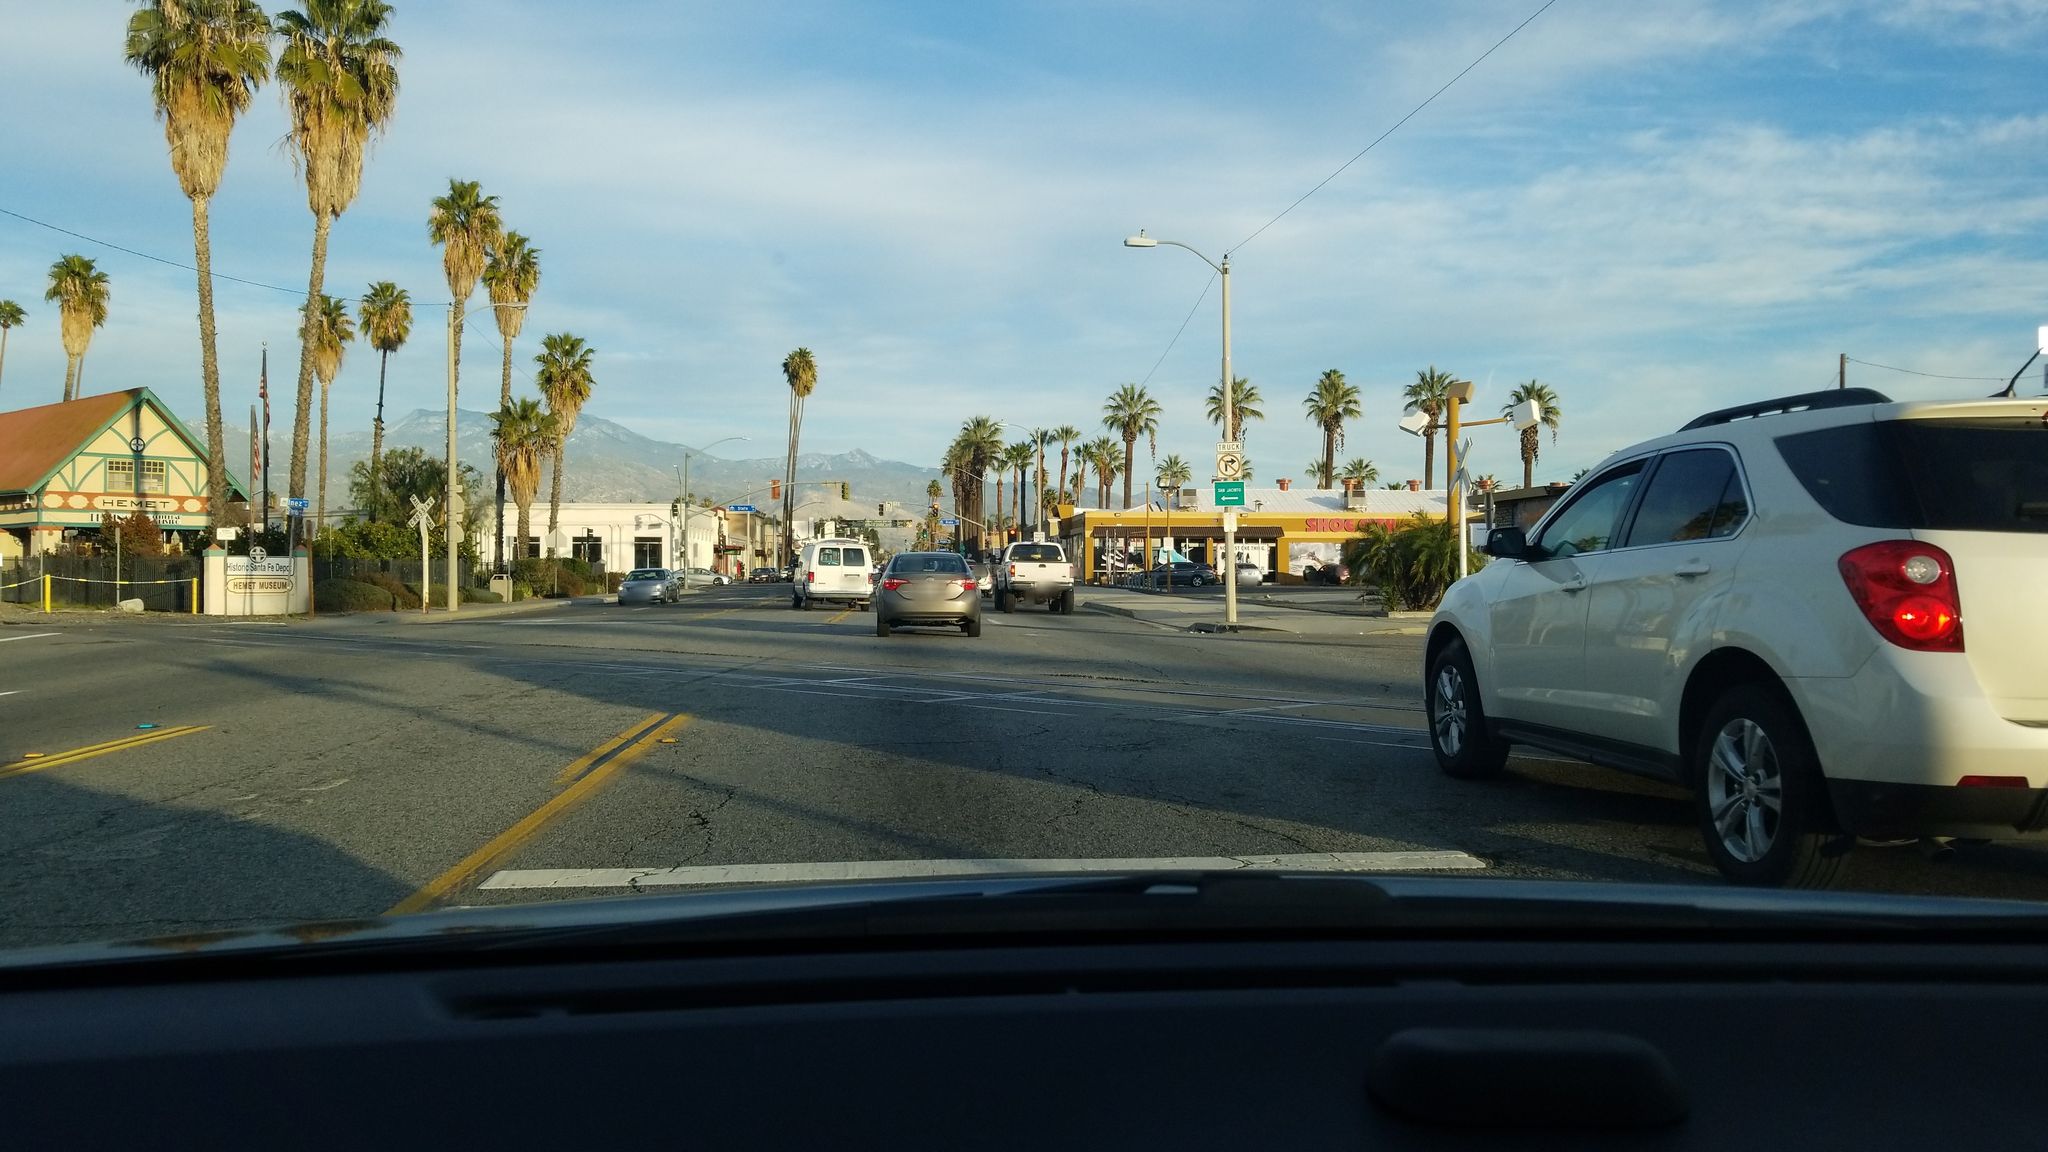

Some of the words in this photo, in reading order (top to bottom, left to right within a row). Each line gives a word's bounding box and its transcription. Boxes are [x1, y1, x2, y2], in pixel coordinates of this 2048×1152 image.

[1218, 443, 1240, 451] TRUCK
[102, 499, 171, 509] HEMET
[409, 498, 434, 526] CROSSING
[1305, 517, 1356, 533] SHOE
[226, 562, 249, 572] Historic
[249, 562, 266, 572] Santa
[267, 562, 275, 572] Fe
[233, 581, 256, 590] HEMET
[258, 581, 288, 590] MUSEUM
